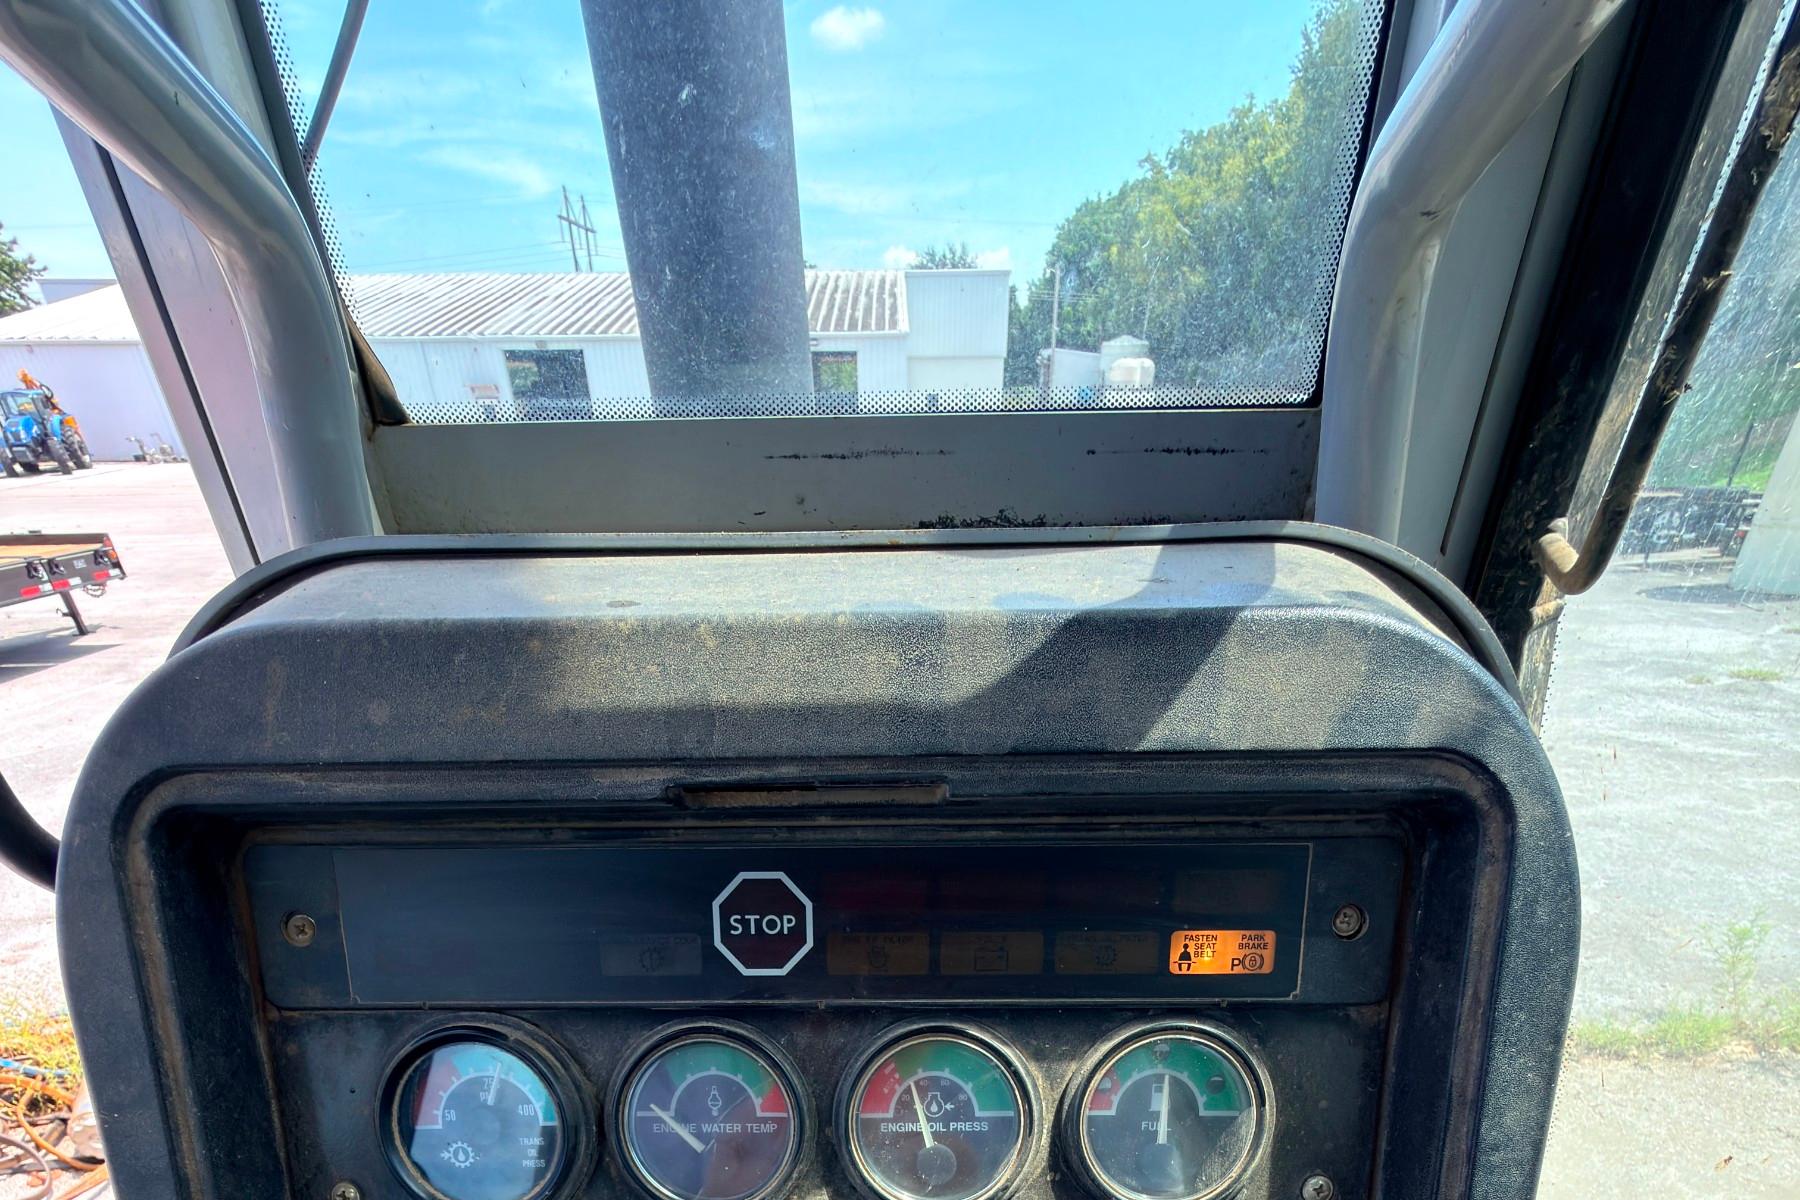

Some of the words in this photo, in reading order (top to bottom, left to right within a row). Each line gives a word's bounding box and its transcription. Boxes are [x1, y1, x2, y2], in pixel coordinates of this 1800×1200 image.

[729, 915, 796, 935] STOP
[1184, 934, 1218, 942] FASTEN
[1241, 934, 1266, 942] PARK
[1238, 942, 1269, 950] BRAKE
[445, 1109, 456, 1121] 50
[517, 1105, 534, 1116] 400
[653, 1123, 696, 1133] ENNE
[702, 1123, 741, 1133] WATER
[746, 1123, 777, 1133] TEMP
[881, 1122, 923, 1132] ENGINE
[926, 1122, 946, 1131] OIL
[950, 1122, 988, 1131] PRESS
[1142, 1121, 1172, 1131] FU
[520, 1137, 545, 1145] TRANS
[523, 1160, 546, 1168] PRESS
